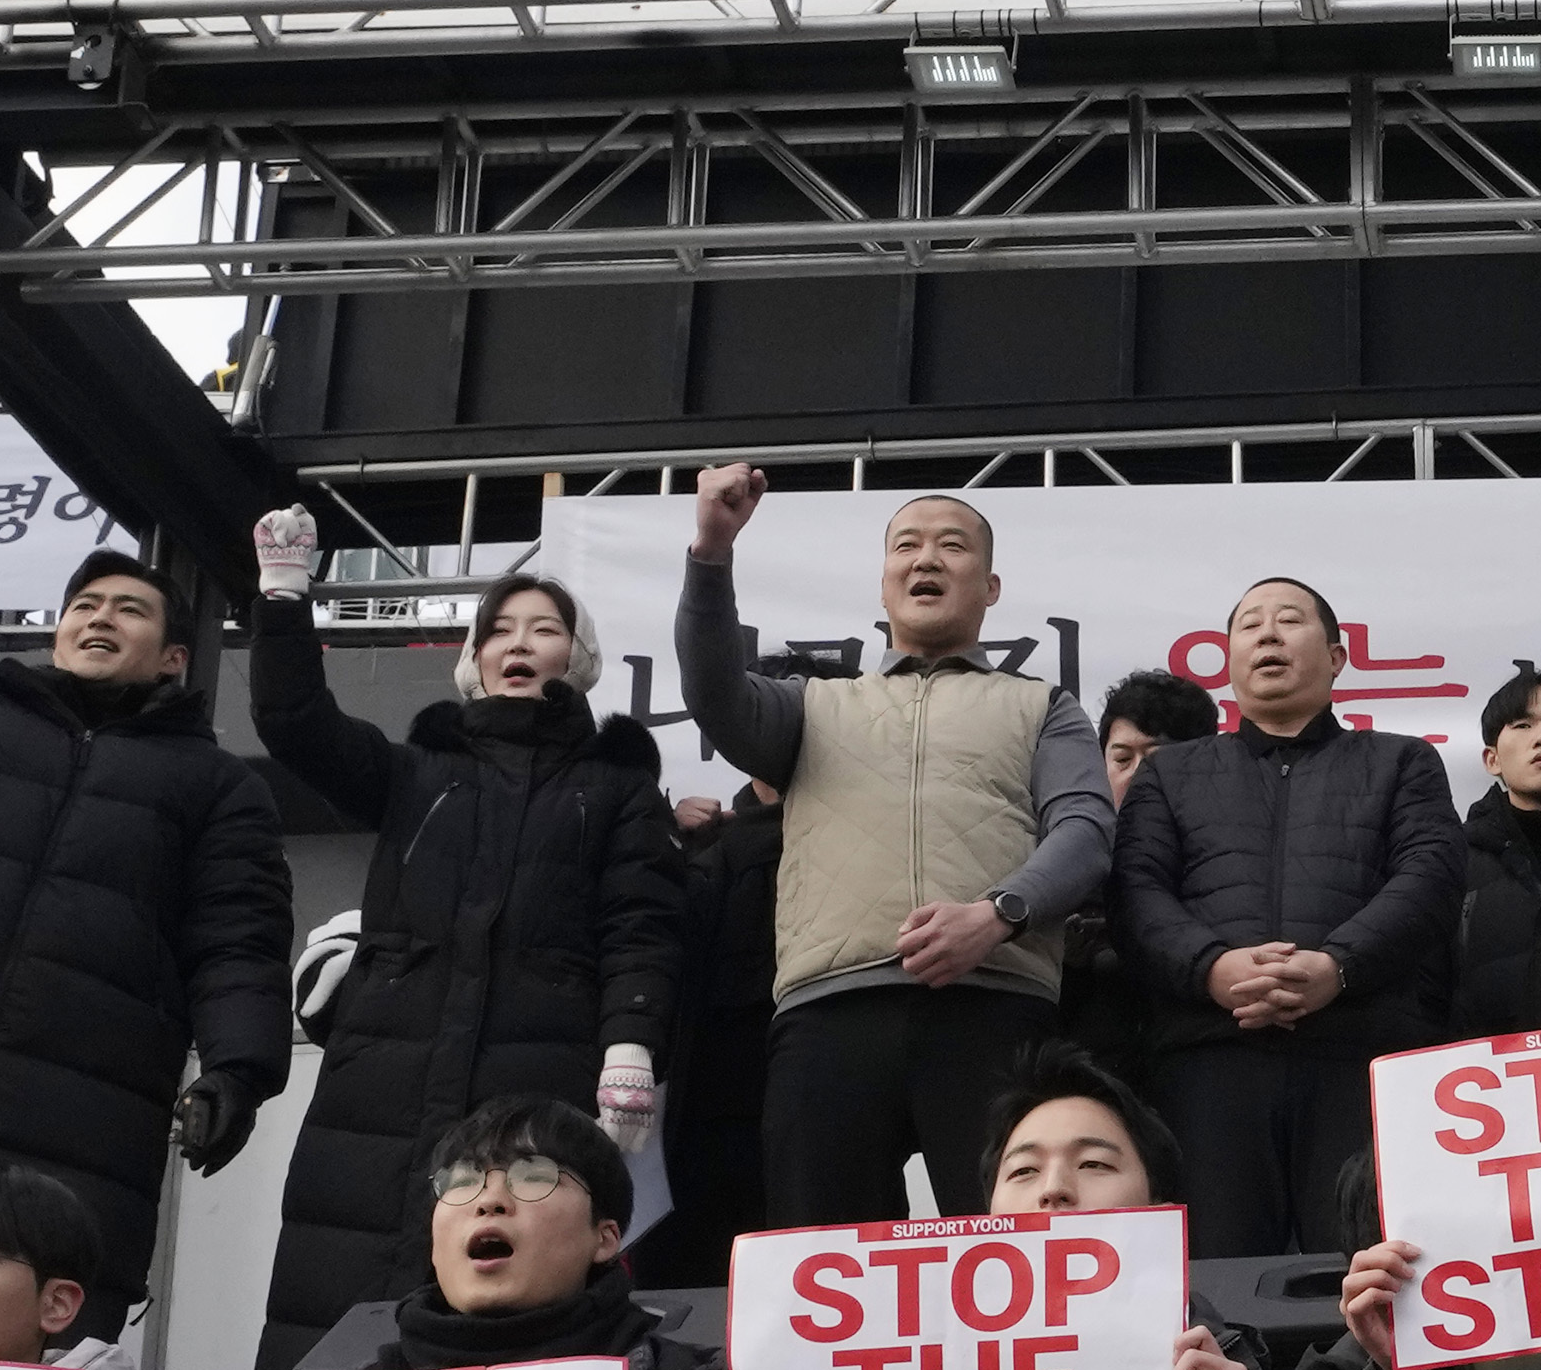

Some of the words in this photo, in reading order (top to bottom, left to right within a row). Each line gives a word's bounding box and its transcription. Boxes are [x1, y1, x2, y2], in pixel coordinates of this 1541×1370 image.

[891, 1219, 968, 1239] SUPPORT
[970, 1217, 1016, 1234] YOON
[788, 1237, 1121, 1343] STOP
